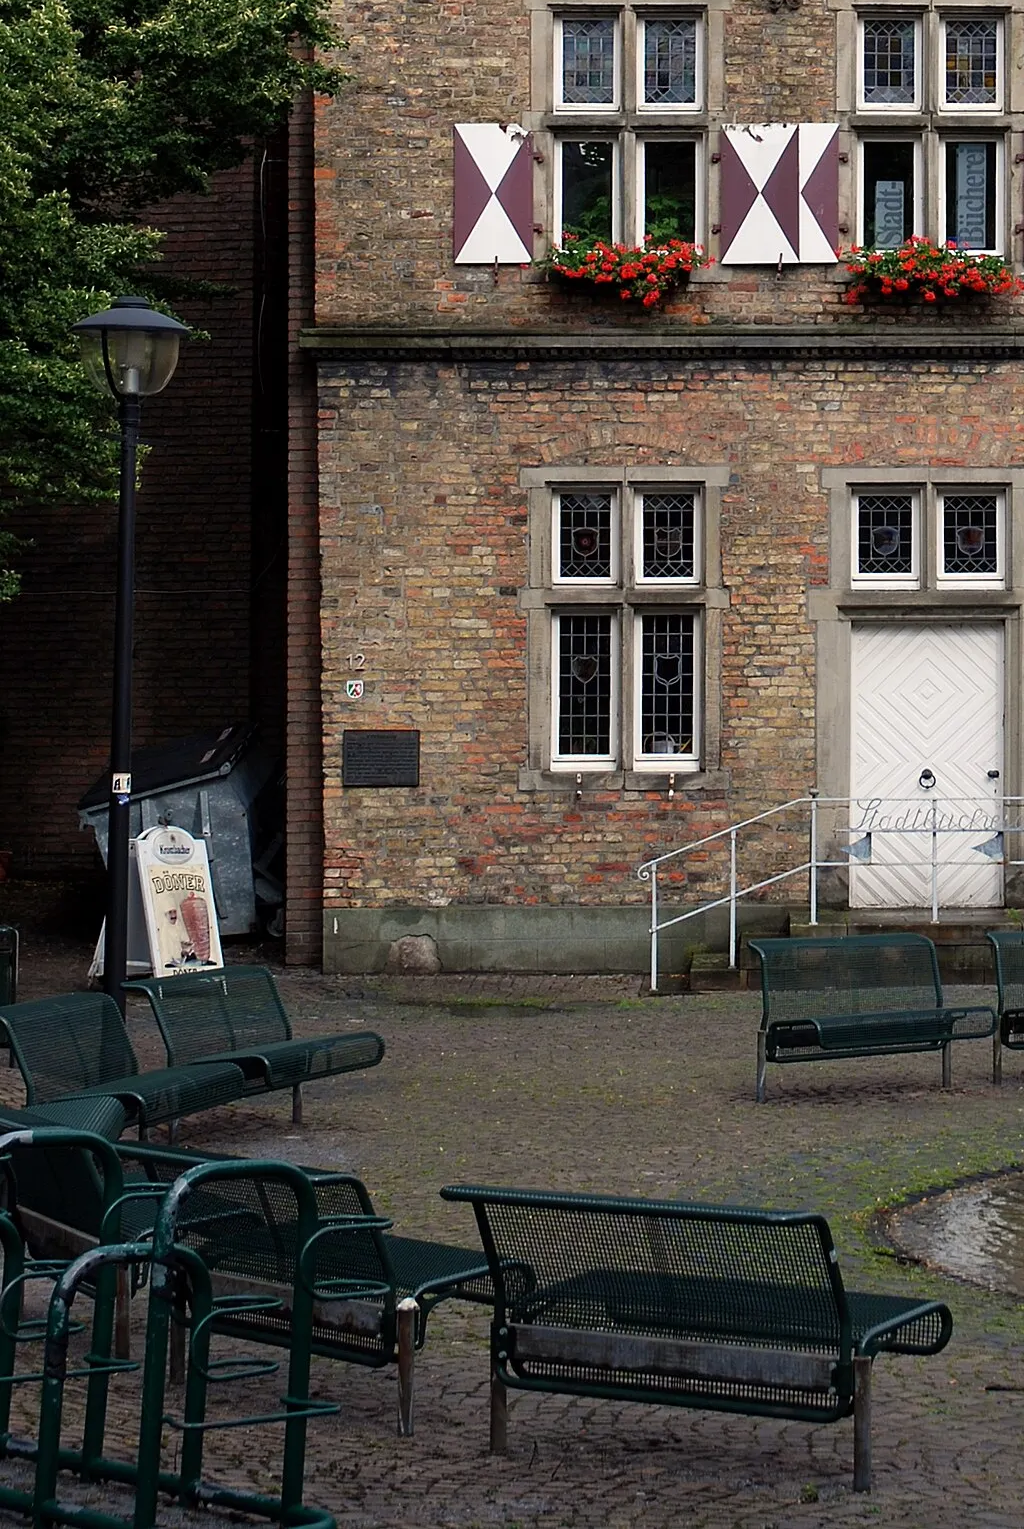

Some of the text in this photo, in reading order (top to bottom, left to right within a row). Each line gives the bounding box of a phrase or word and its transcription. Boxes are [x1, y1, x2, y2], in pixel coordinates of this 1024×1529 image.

[877, 181, 903, 246] Stadt-
[958, 145, 985, 244] Bücherei
[346, 653, 365, 670] 12
[152, 870, 205, 894] DÖNER
